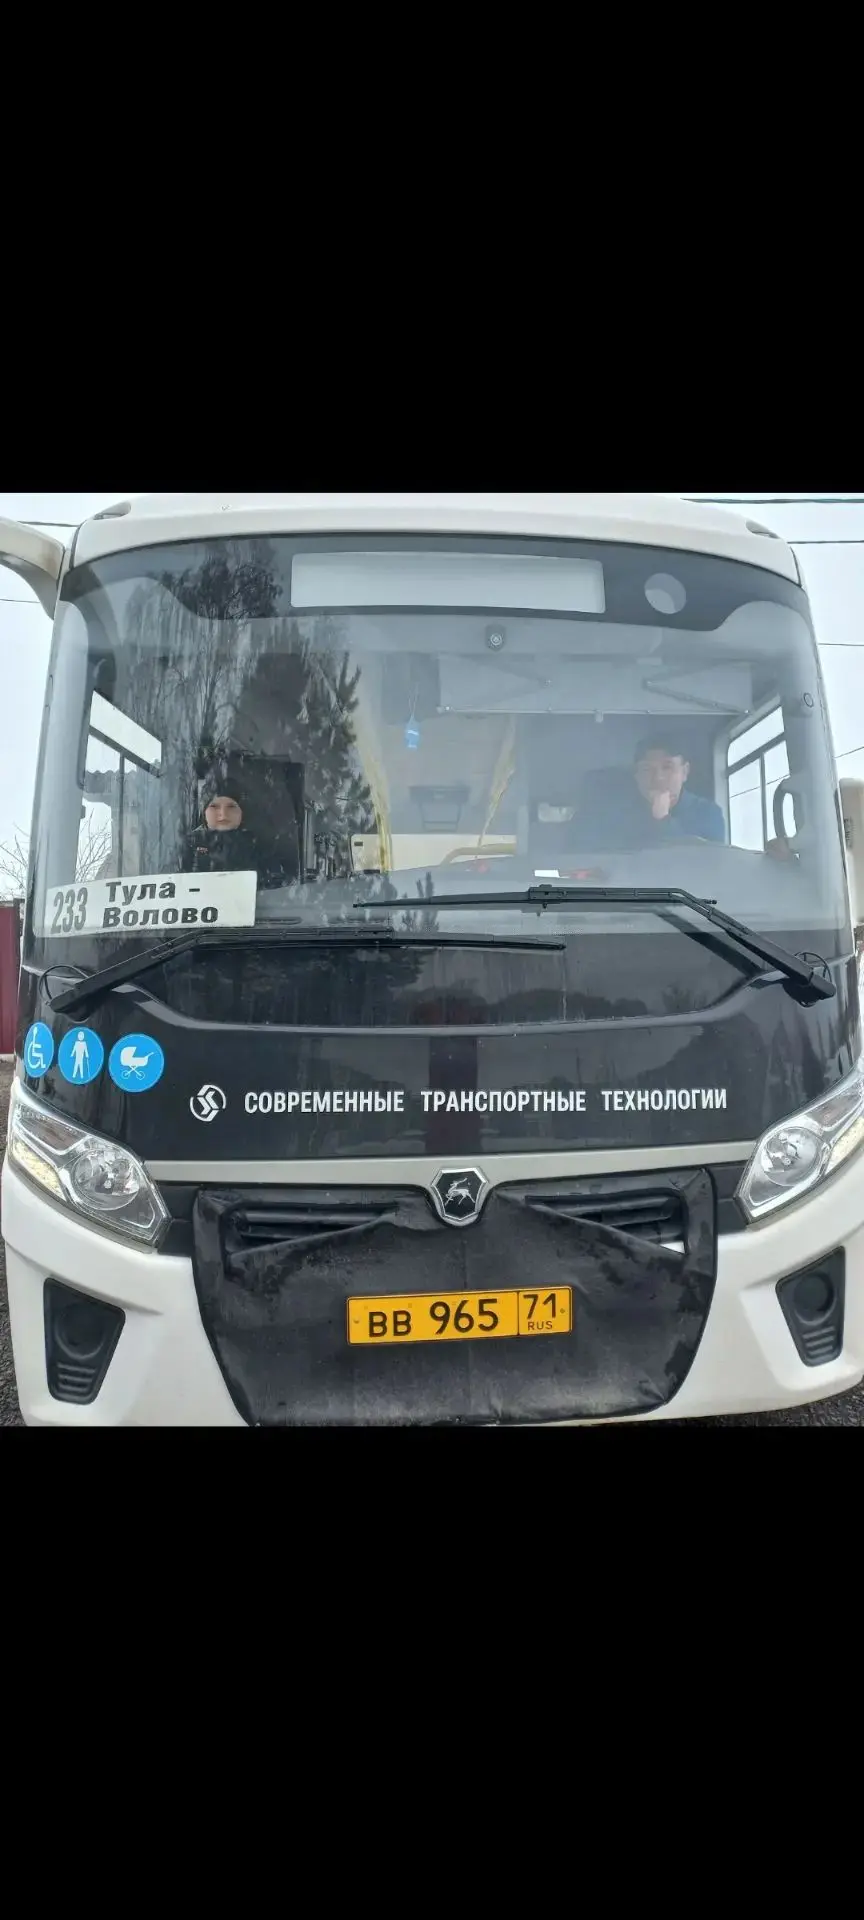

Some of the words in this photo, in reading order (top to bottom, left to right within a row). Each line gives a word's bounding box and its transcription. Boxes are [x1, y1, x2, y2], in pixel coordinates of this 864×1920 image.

[106, 881, 176, 905] Тула
[51, 887, 88, 933] 233
[102, 906, 218, 928] Волово
[244, 1091, 405, 1113] СОВРЕМЕННЫЕ
[420, 1090, 586, 1111] ТРАНСПОРТНЫЕ
[601, 1089, 727, 1110] ТЕХНОЛОГИИ
[429, 1298, 499, 1334] 965
[523, 1293, 557, 1319] 71
[527, 1321, 553, 1330] RUS
